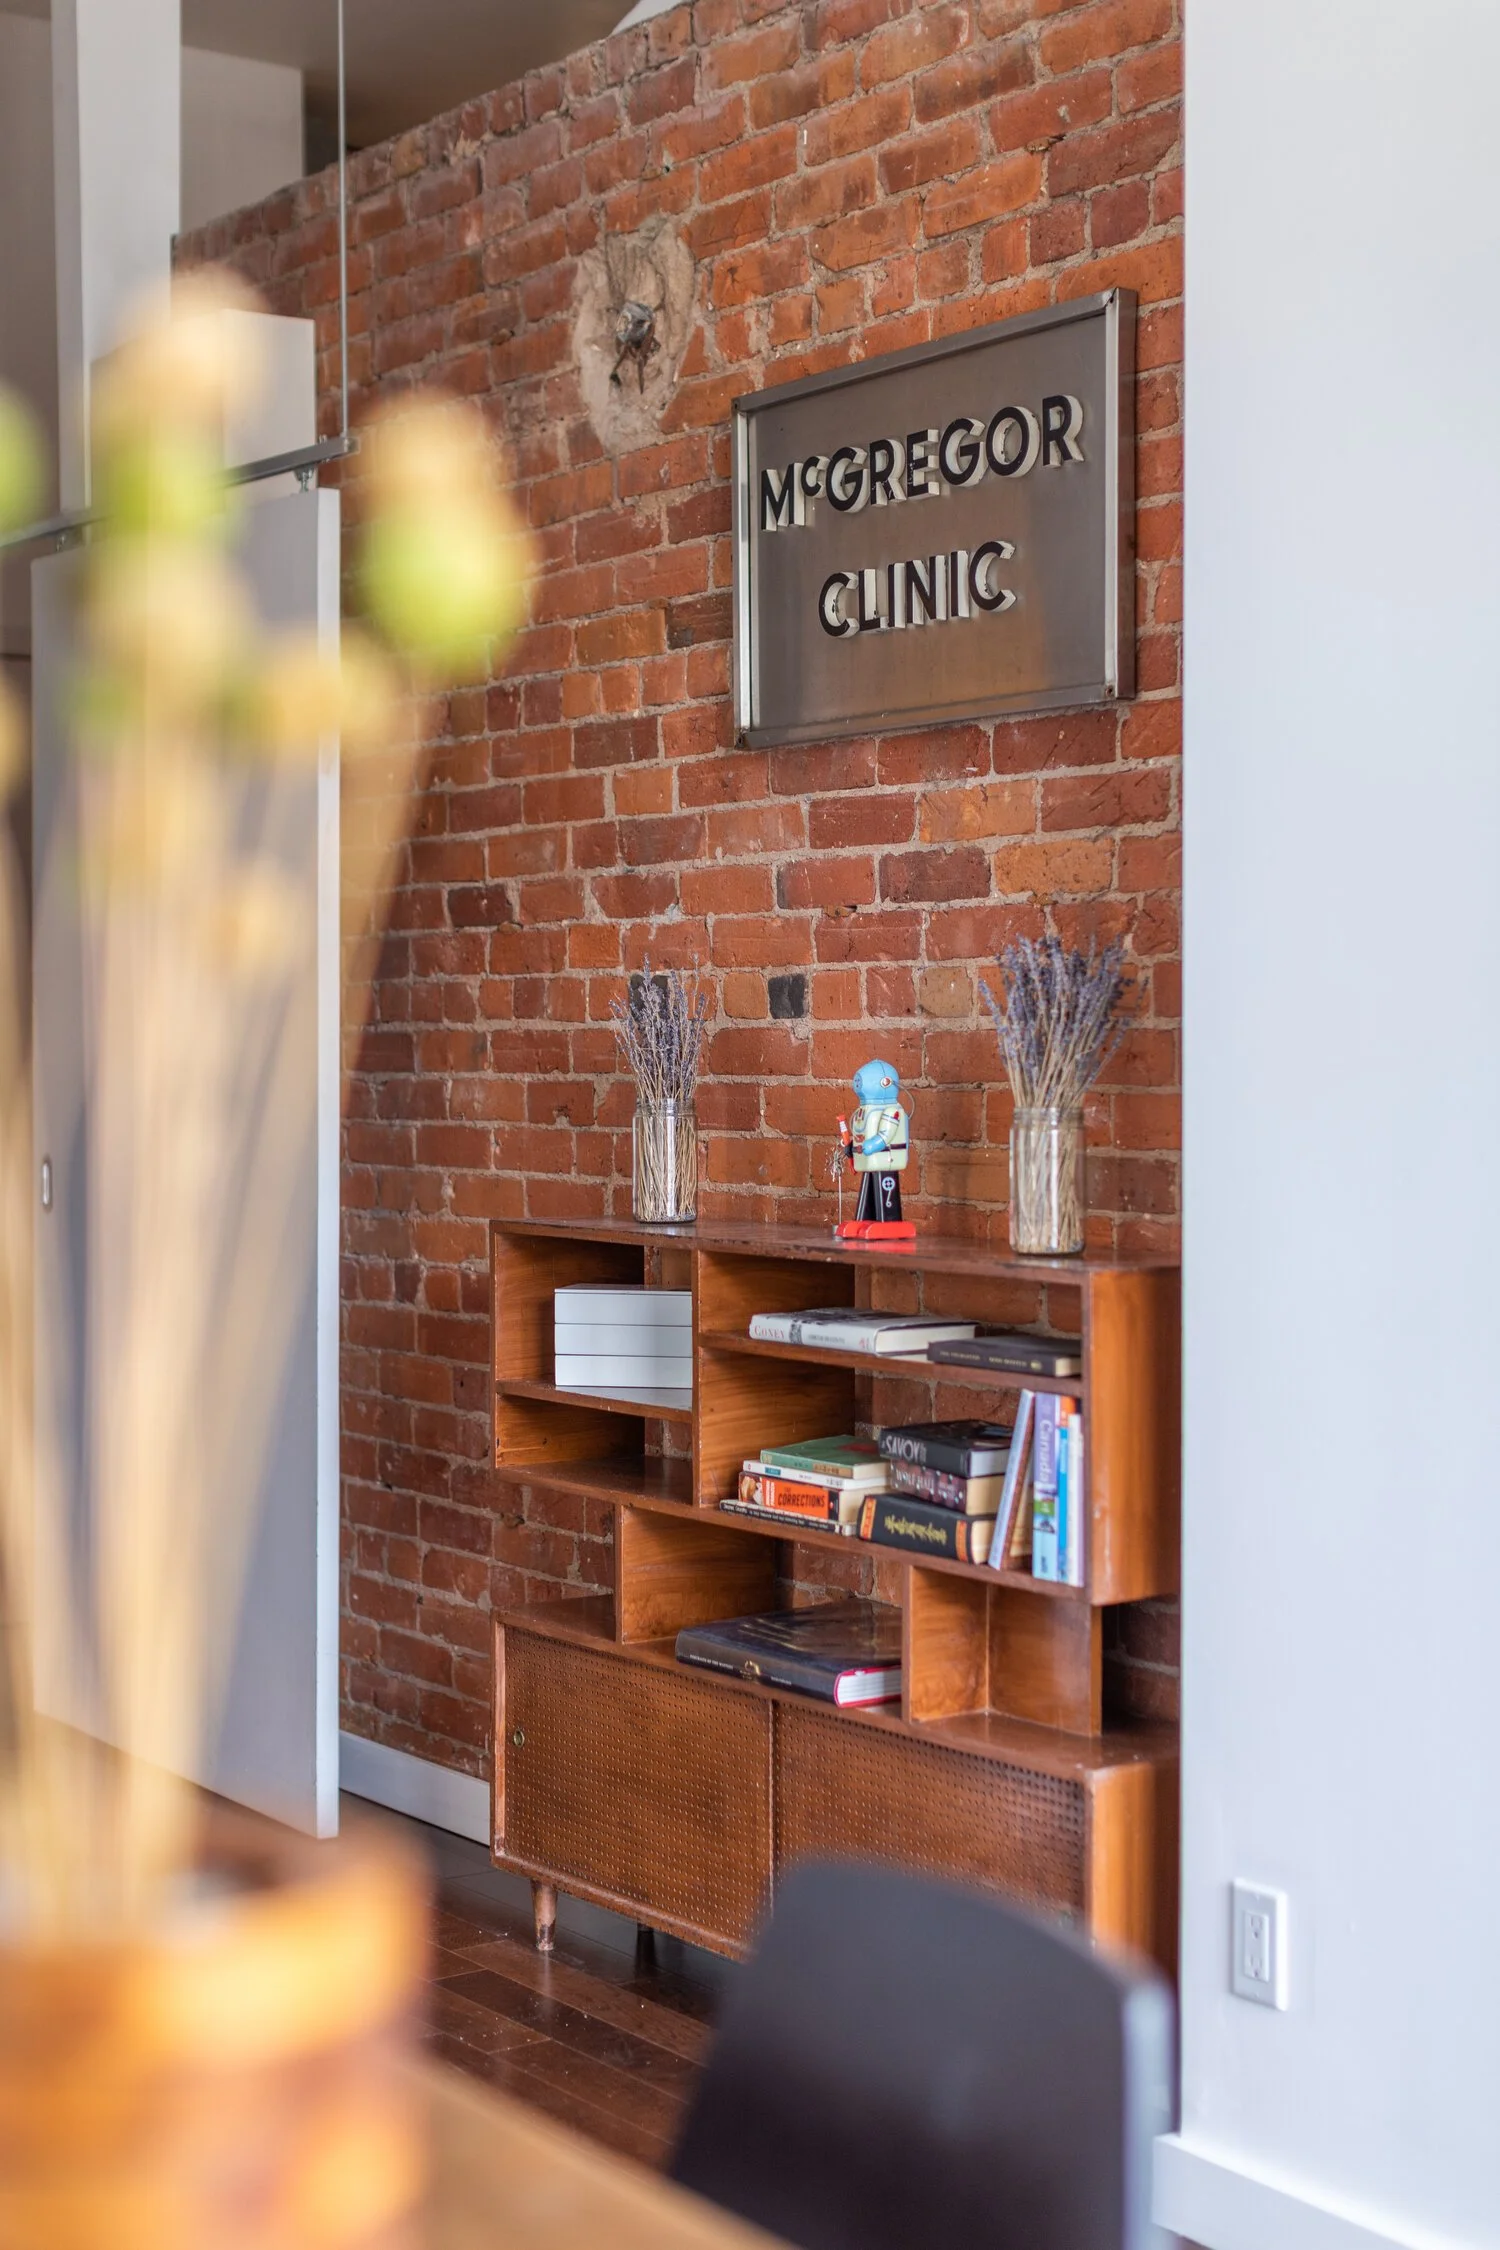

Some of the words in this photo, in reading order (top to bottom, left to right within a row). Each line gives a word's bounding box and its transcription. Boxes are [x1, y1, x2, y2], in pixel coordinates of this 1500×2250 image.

[760, 394, 1085, 532] McGREGOR
[818, 540, 1017, 638] CLINIC
[754, 1325, 785, 1340] CONEY
[885, 1435, 920, 1463] SAVOY
[1039, 1419, 1053, 1482] Canada
[777, 1492, 826, 1509] CORRECTIONS
